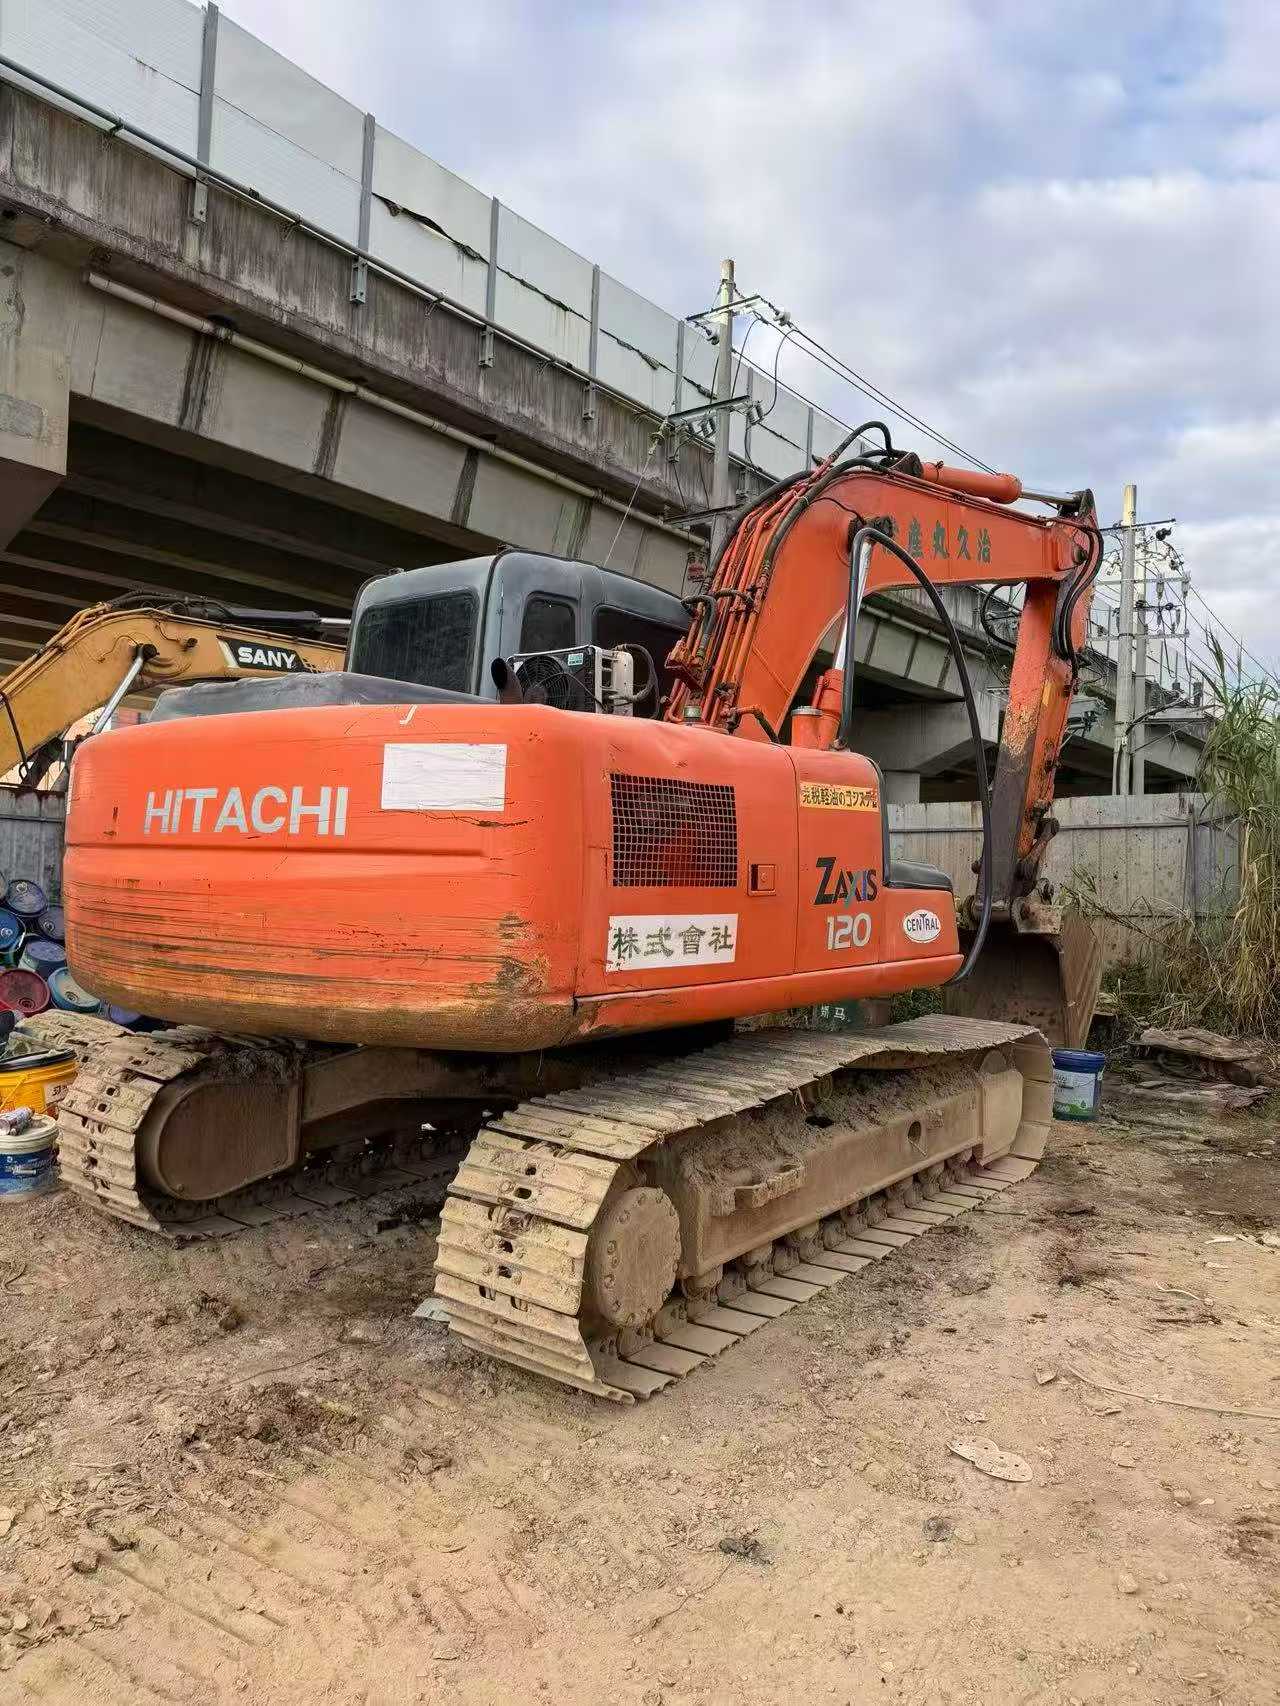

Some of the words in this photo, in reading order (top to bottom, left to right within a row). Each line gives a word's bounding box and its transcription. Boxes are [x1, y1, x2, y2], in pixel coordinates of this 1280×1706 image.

[238, 646, 296, 669] SANY
[144, 785, 349, 836] HITACHI
[814, 856, 878, 908] ZAXIS
[827, 912, 872, 950] 120
[905, 913, 940, 932] CENTRAL
[611, 925, 734, 959] 株式會社
